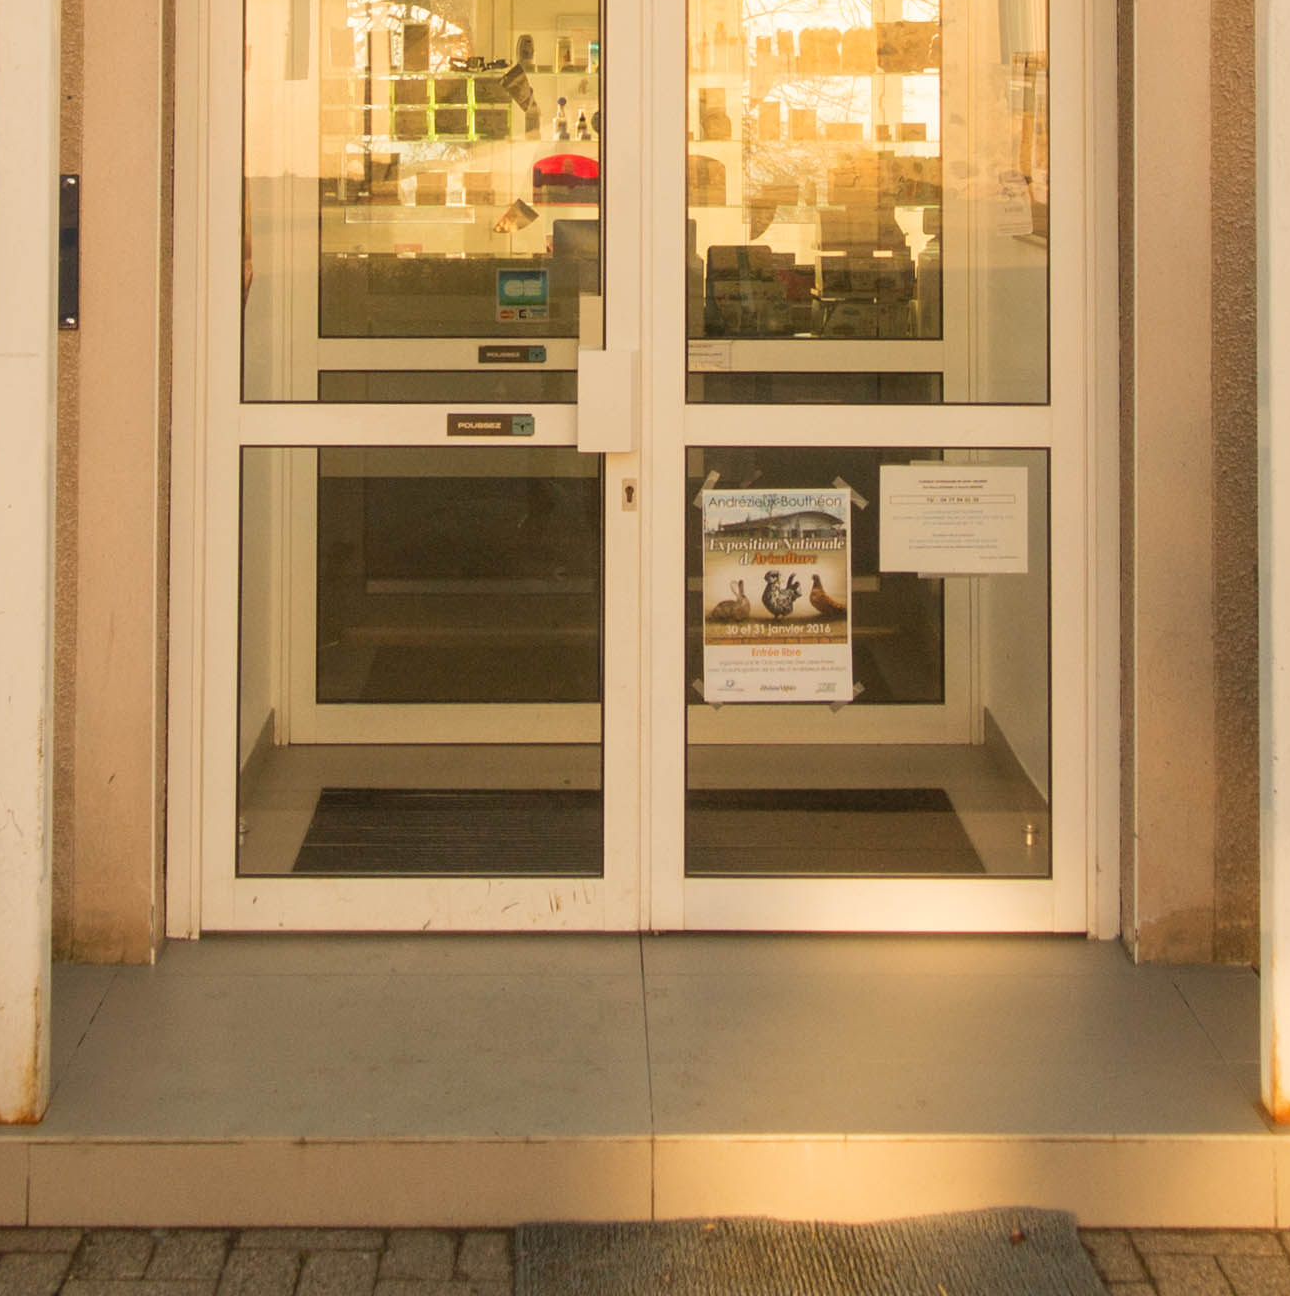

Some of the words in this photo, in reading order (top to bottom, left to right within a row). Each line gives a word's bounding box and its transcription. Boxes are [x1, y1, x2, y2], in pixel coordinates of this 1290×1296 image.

[709, 538, 779, 553] Exposition
[782, 537, 845, 551] Nationale
[726, 624, 739, 635] 30
[740, 624, 752, 634] et
[755, 624, 765, 634] 31
[806, 623, 831, 634] 2016
